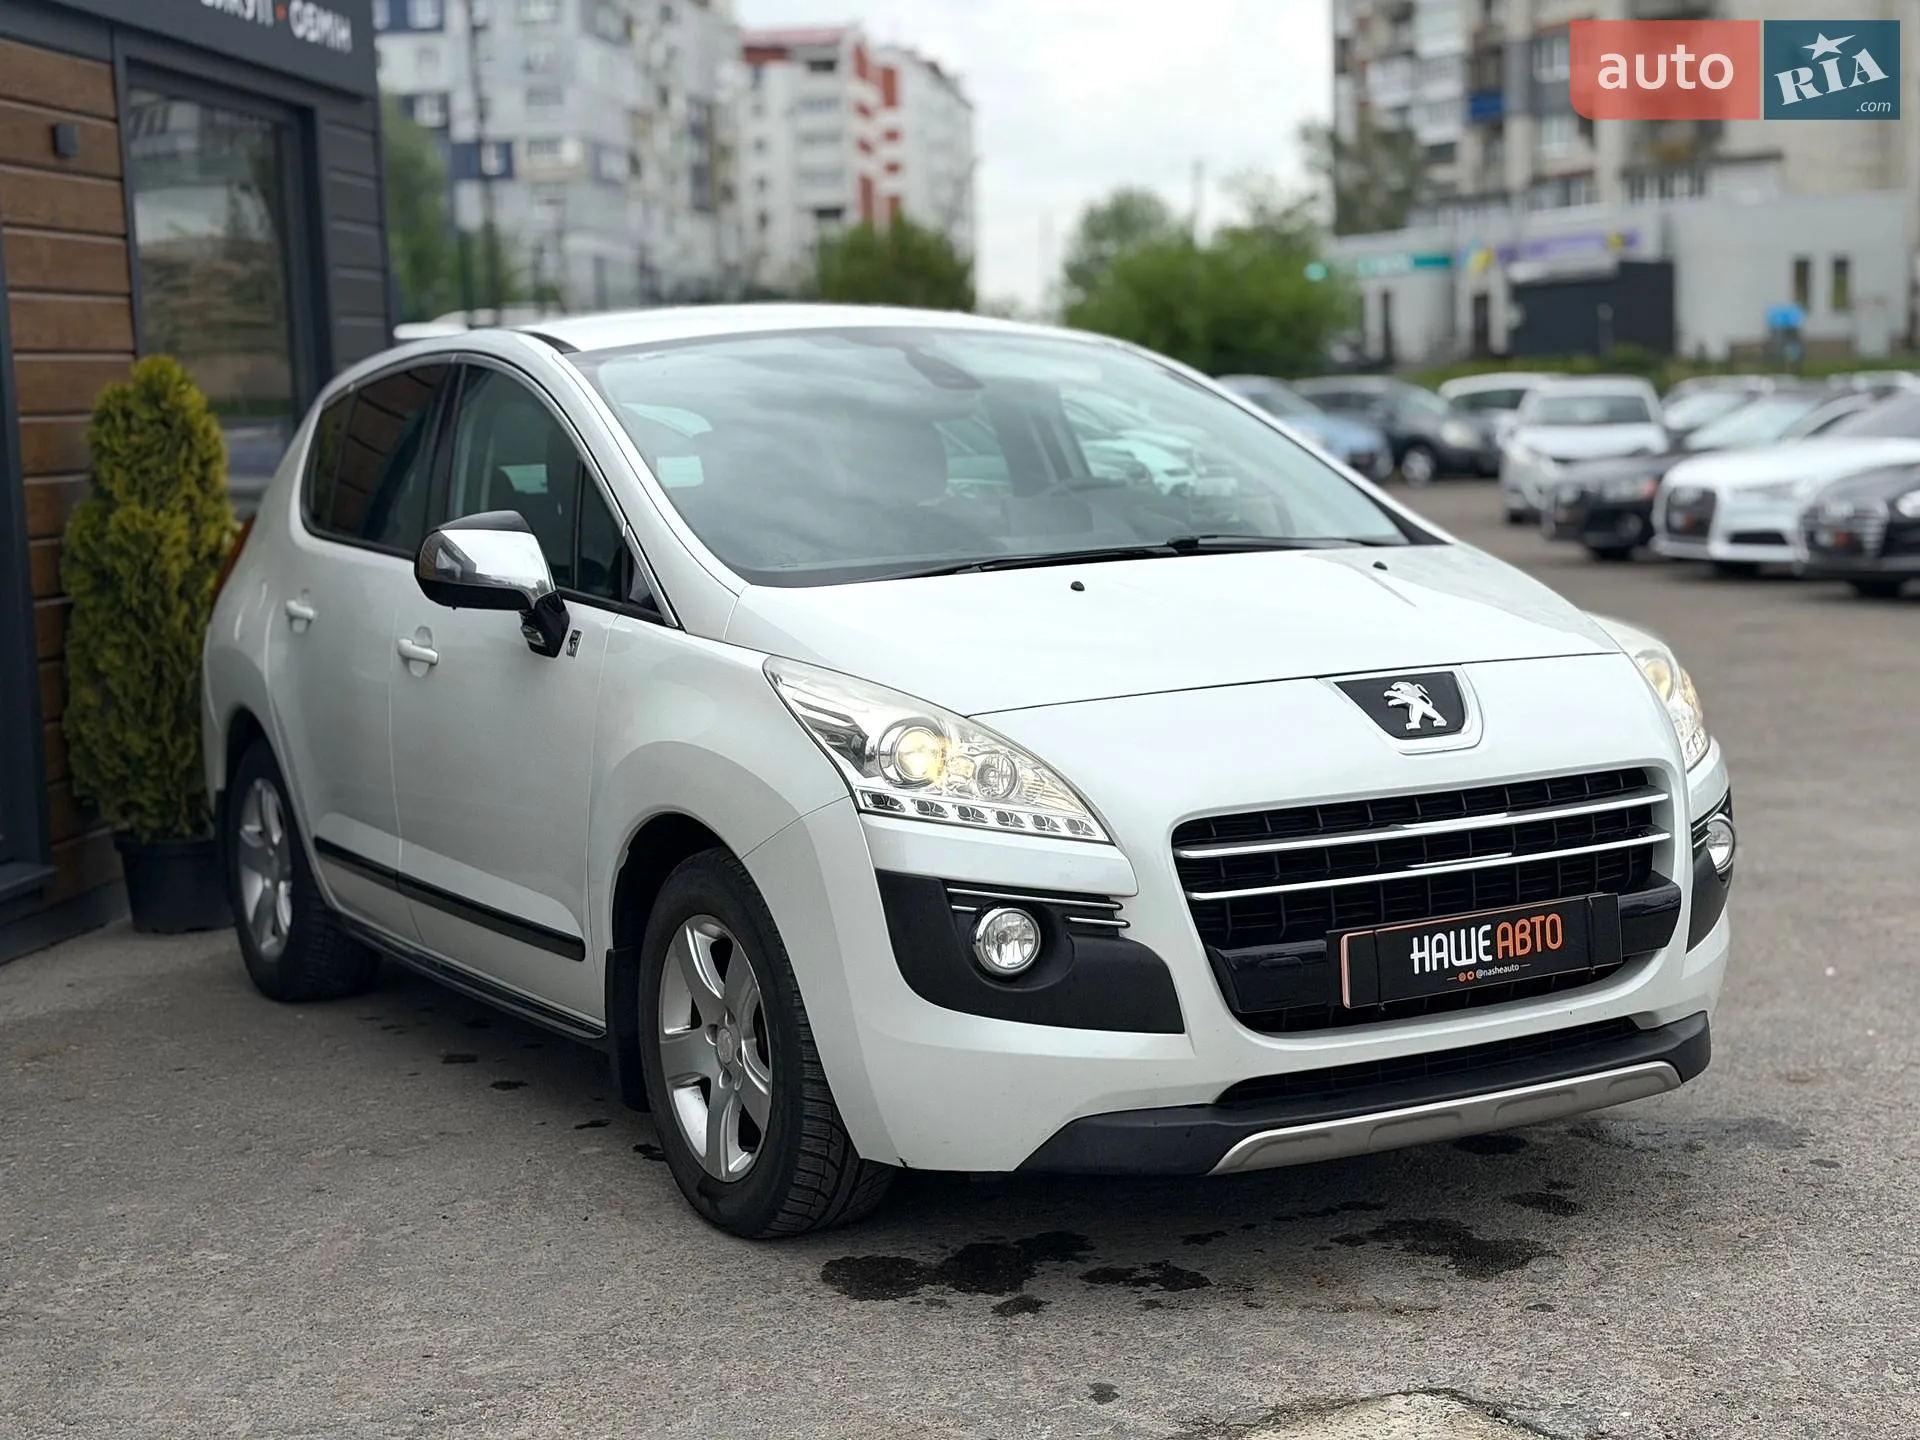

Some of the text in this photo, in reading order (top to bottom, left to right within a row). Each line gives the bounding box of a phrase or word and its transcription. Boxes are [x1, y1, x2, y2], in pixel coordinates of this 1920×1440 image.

[1410, 913, 1563, 974] НАШЕ АВТО
[1475, 963, 1520, 979] @nasheauto
